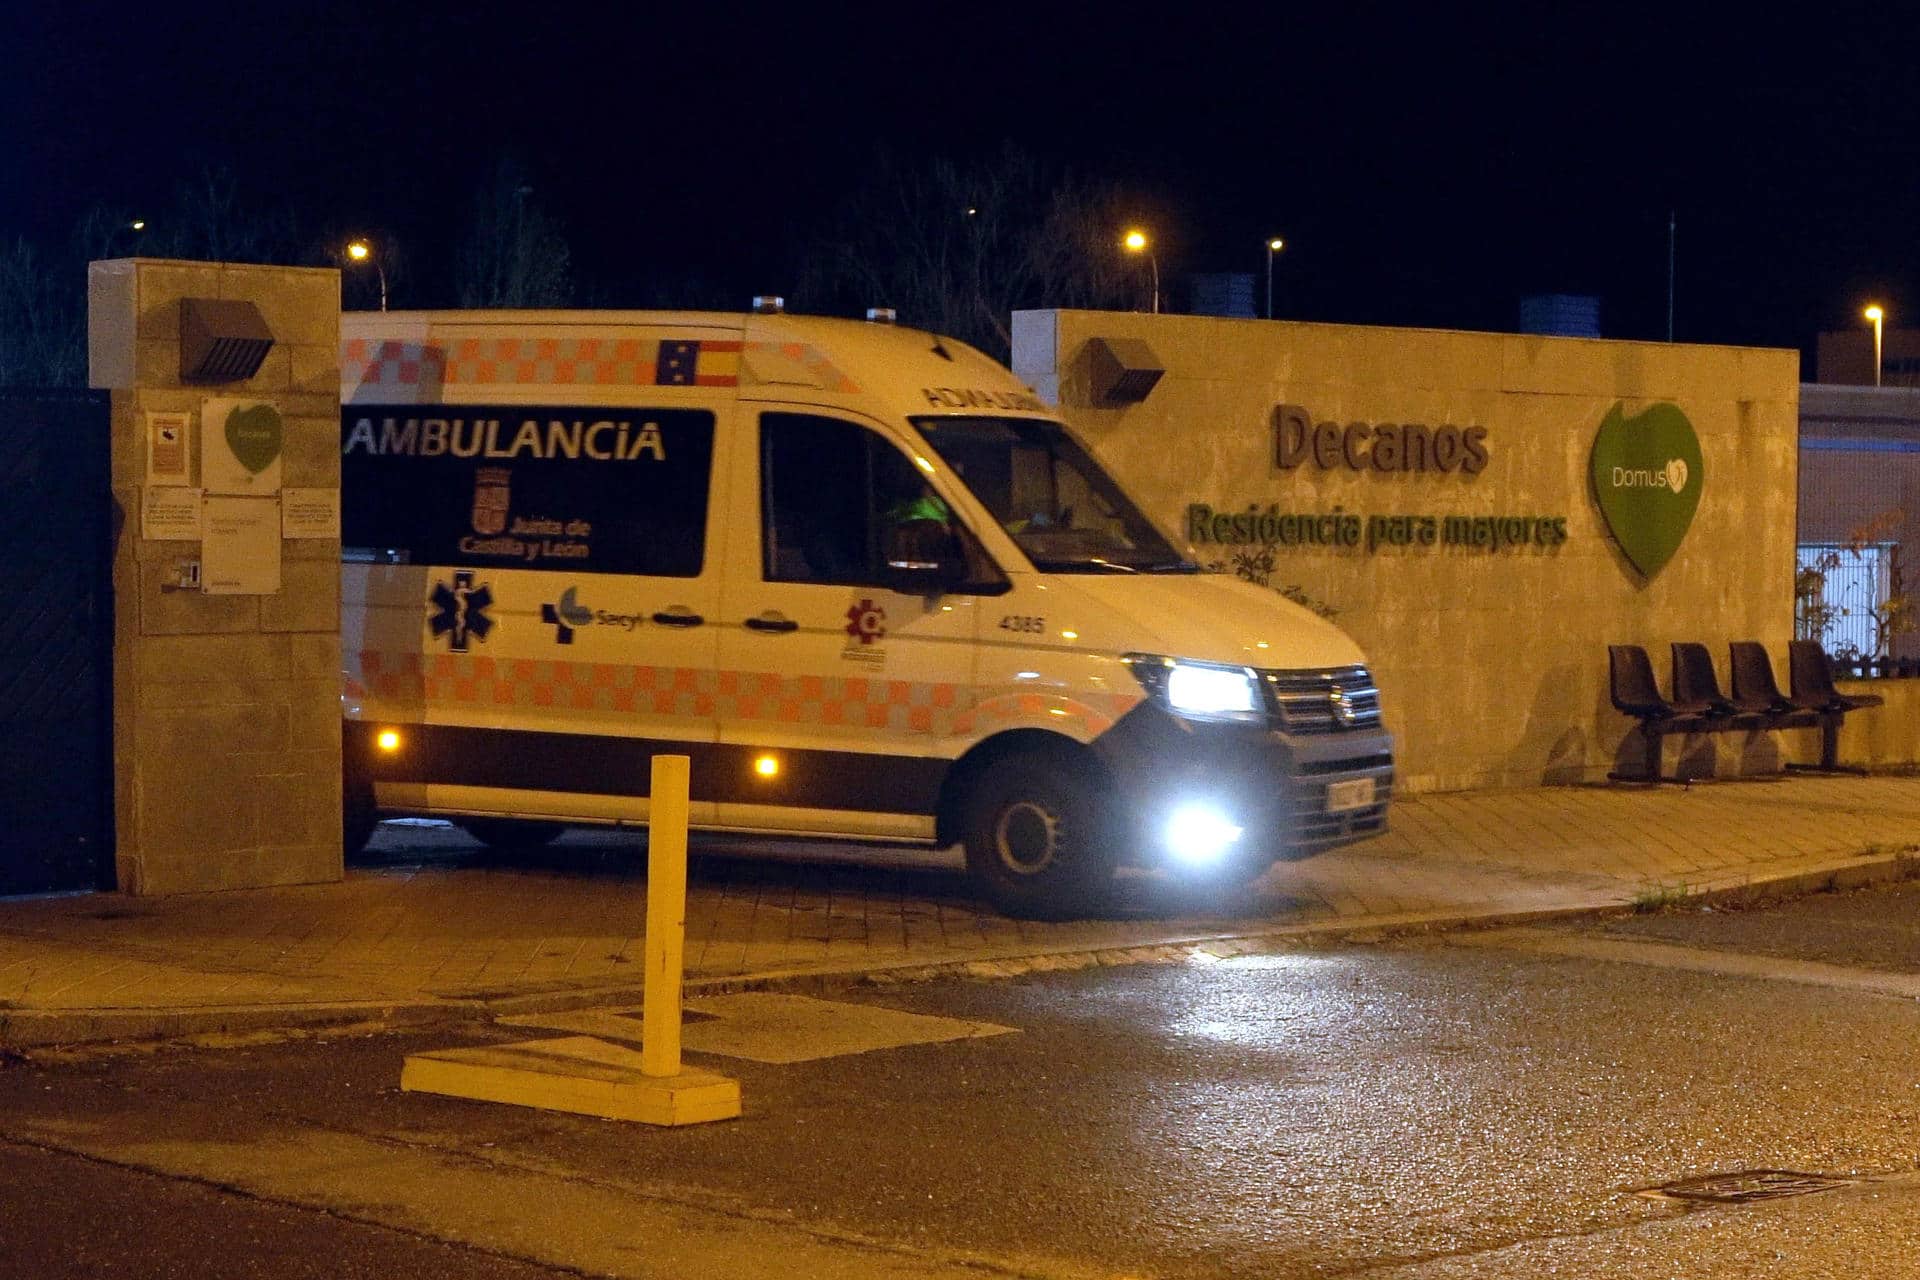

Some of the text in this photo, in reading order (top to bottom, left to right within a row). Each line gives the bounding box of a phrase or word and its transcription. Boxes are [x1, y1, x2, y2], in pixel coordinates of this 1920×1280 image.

[343, 417, 666, 460] AMBULANCIA
[1273, 403, 1490, 474] Decanos
[1188, 503, 1568, 553] Residencia para mayores
